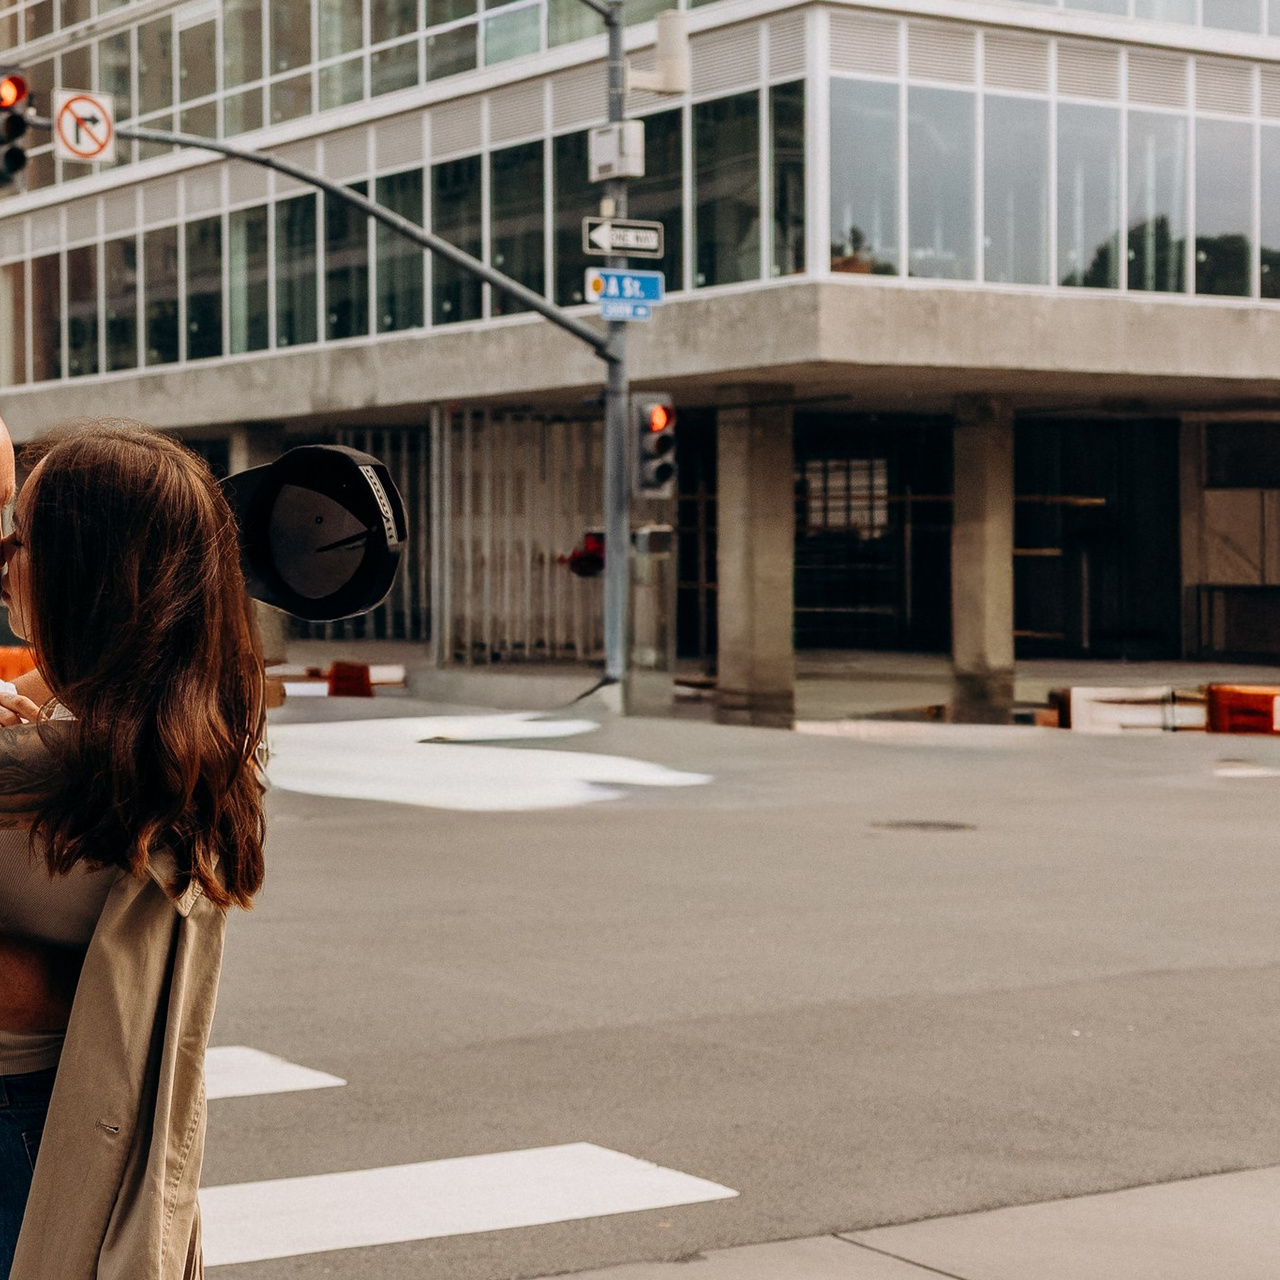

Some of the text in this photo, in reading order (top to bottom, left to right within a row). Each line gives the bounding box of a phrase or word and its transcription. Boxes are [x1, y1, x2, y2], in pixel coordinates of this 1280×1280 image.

[611, 231, 656, 246] ONE WAY
[606, 276, 646, 299] A St.
